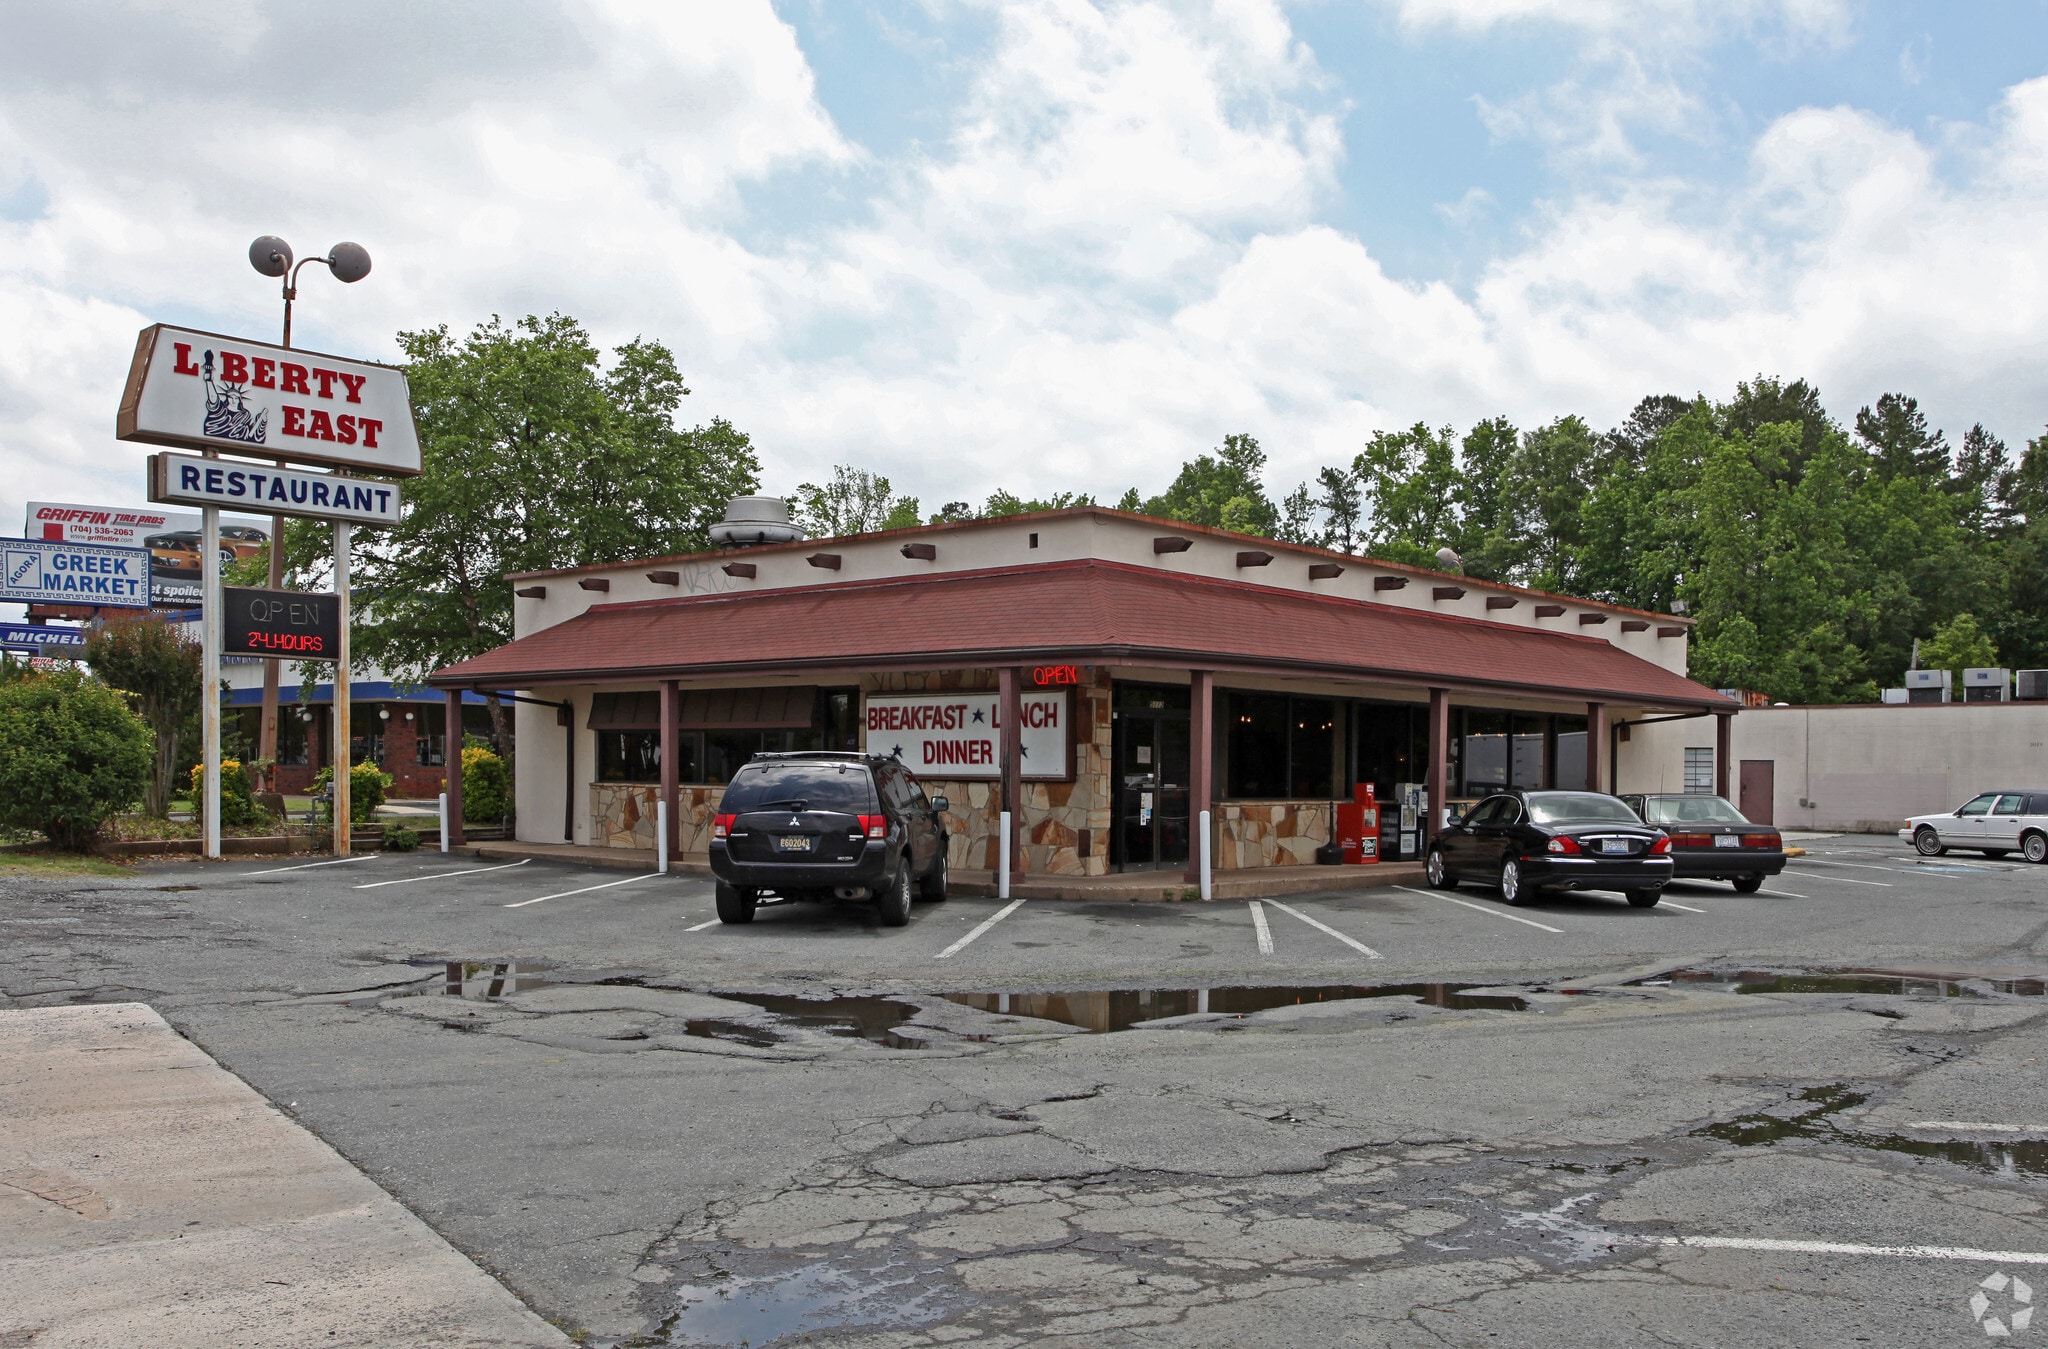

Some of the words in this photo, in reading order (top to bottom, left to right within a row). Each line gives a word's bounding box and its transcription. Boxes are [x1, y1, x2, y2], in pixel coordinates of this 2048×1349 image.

[281, 405, 383, 448] EAST
[181, 465, 391, 513] RESTAURANT
[36, 507, 111, 525] GRIFFIN
[112, 513, 137, 525] TIRE
[135, 515, 166, 527] PROS
[70, 525, 92, 534] (704)
[94, 526, 134, 536] 536-2063
[10, 555, 38, 585] AGORA
[52, 553, 129, 576] GREEK
[43, 573, 139, 596] MARKET
[250, 599, 319, 625] OPEN
[7, 631, 87, 645] MICHEL
[248, 631, 269, 647] 24
[273, 633, 323, 651] HOURS
[1033, 666, 1077, 685] OPEN
[867, 704, 968, 731] BREAKFAST
[991, 702, 1058, 729] LNCH
[923, 739, 993, 765] DINNER
